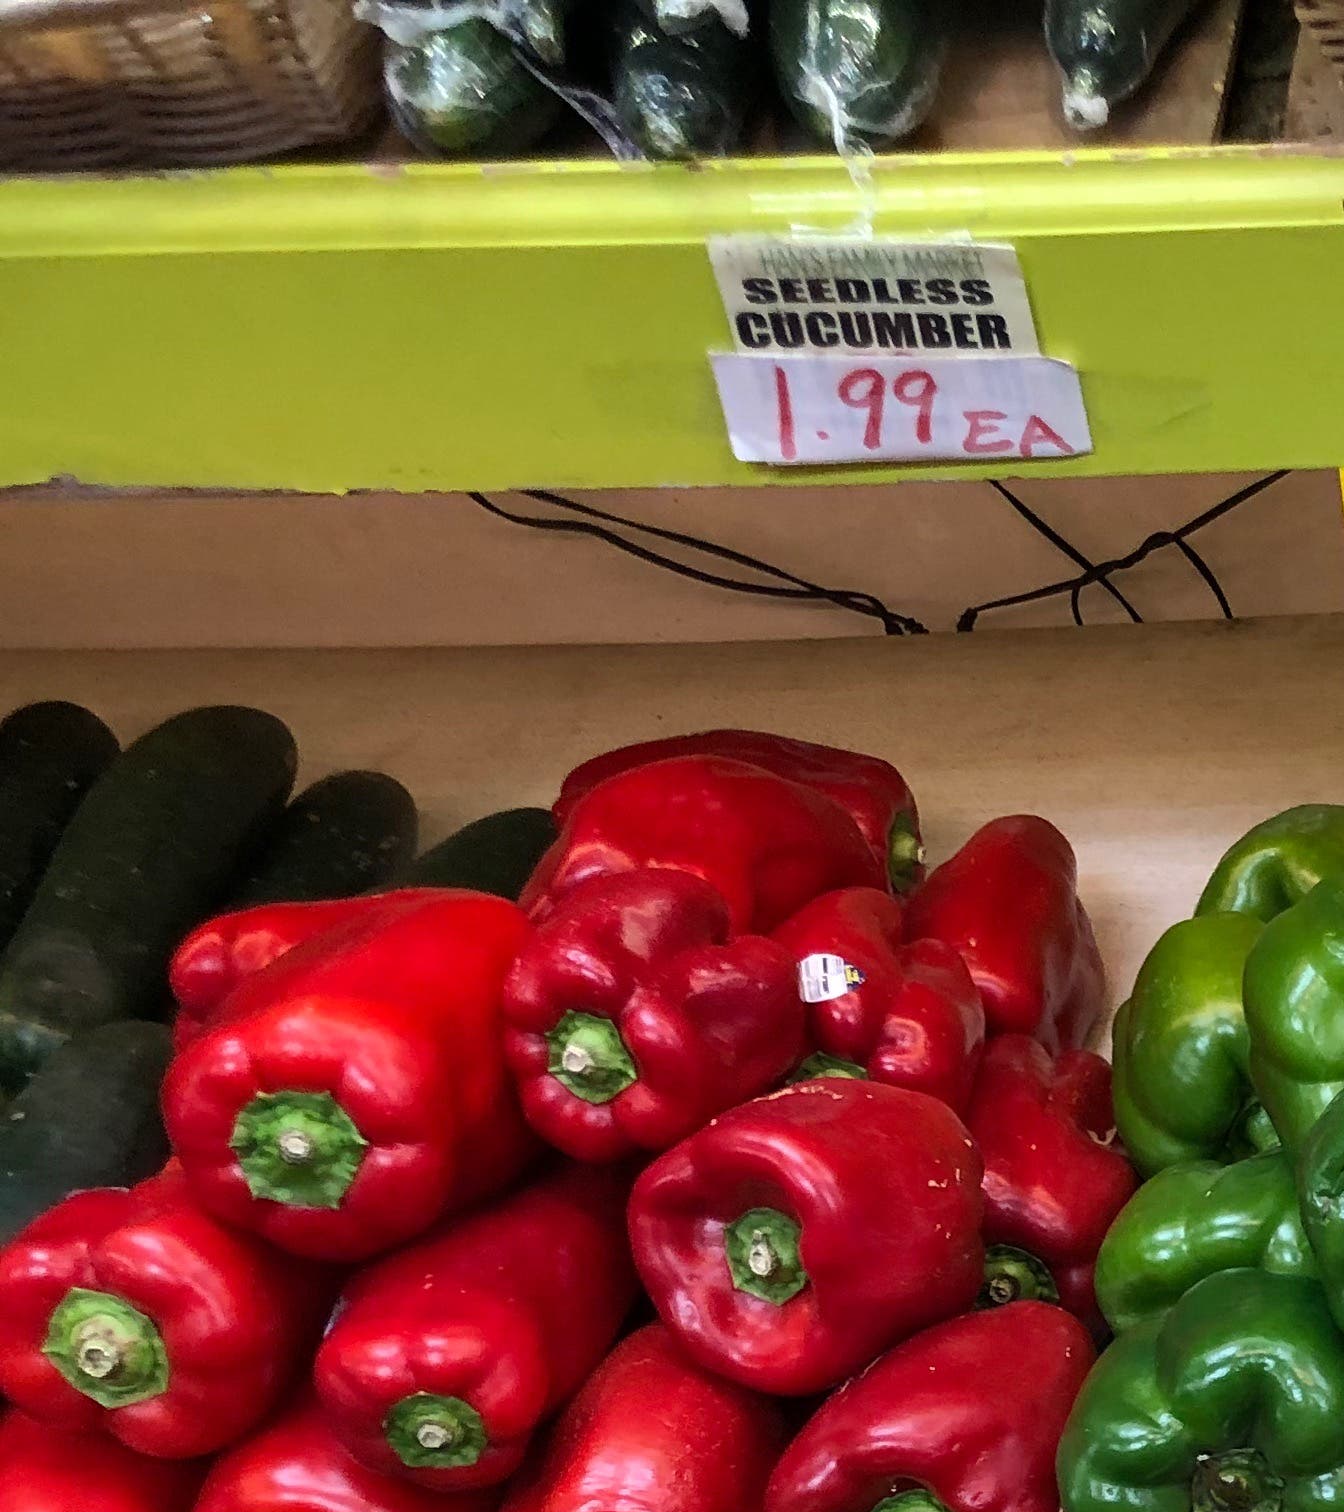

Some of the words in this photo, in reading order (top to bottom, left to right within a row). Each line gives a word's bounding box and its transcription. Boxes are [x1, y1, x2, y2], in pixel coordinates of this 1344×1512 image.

[742, 277, 994, 305] SEEDLESS
[735, 312, 1011, 349] CUCUMBER
[774, 366, 937, 460] 1.99
[962, 411, 1074, 458] EA
